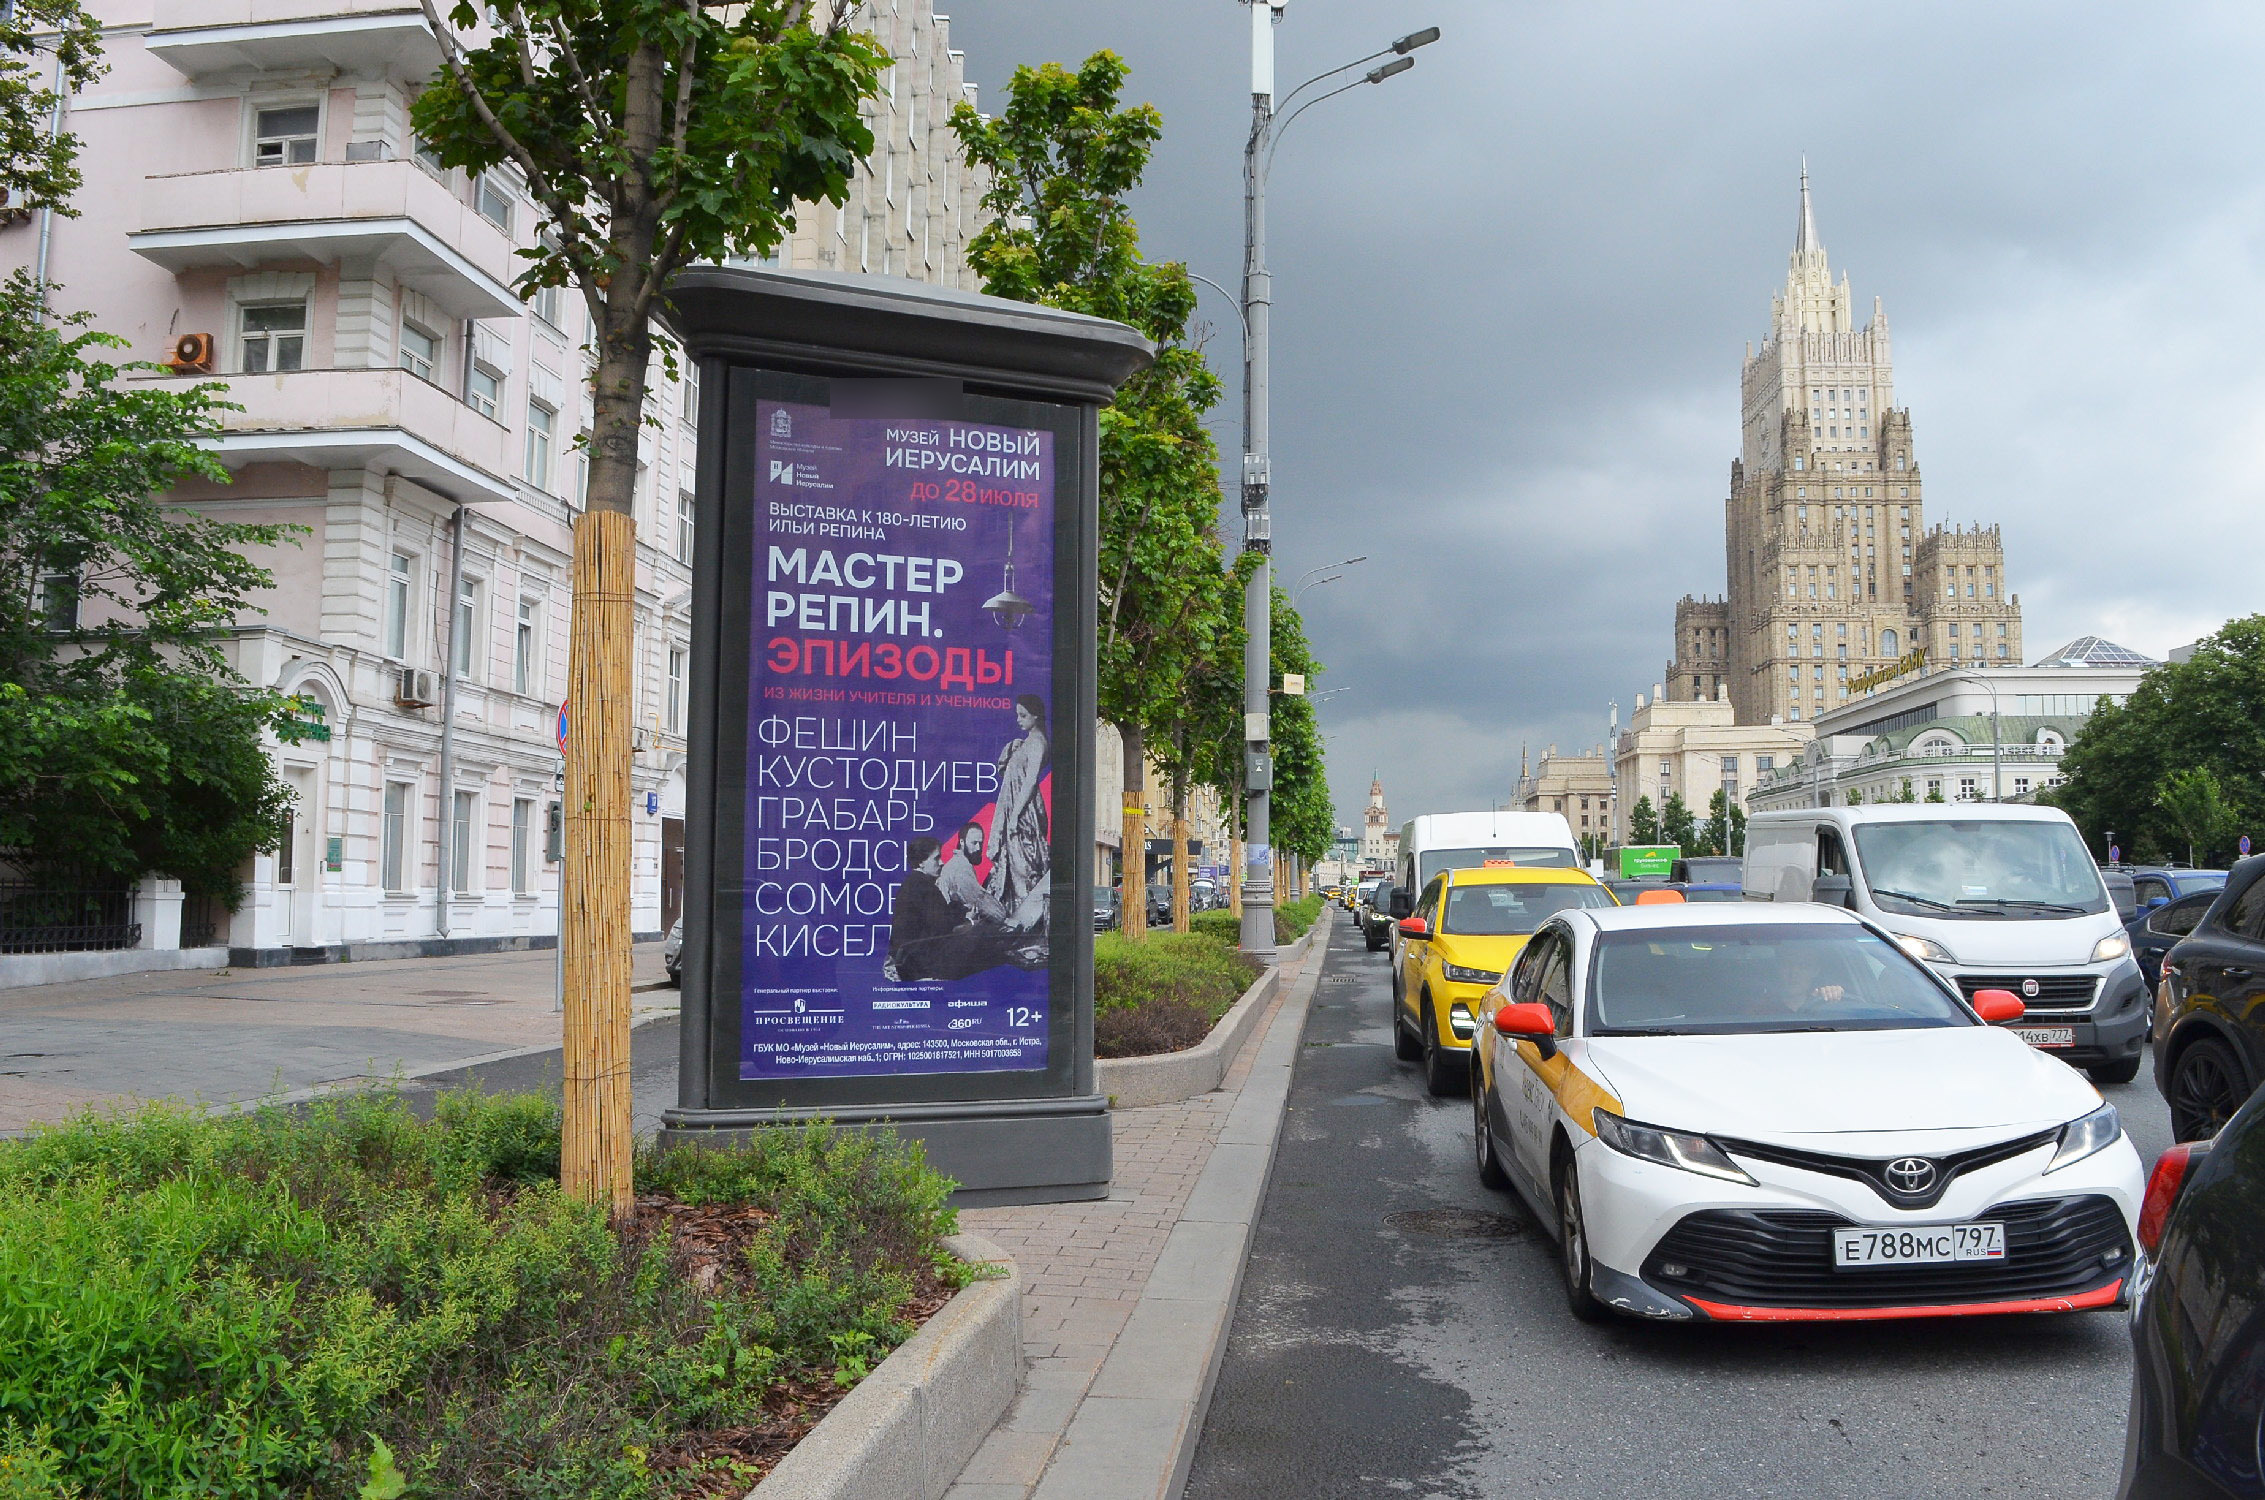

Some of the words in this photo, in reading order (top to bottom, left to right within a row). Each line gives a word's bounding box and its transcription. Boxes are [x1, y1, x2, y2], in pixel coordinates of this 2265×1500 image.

[887, 428, 939, 445] МУЗЕЙ
[950, 428, 1039, 456] НОВЫЙ
[886, 447, 1040, 480] ИЕРУСАЛИМ
[910, 481, 941, 502] ДО
[945, 479, 977, 504] 28
[980, 488, 1040, 509] ИЮЛЯ
[769, 501, 857, 522] ВЫСТАВКА
[862, 510, 873, 524] К
[876, 511, 967, 532] 180-ЛЕТИЮ
[769, 518, 815, 535] ИЛЬИ
[819, 523, 886, 541] РЕПИНА
[767, 545, 964, 594] МАСТЕР
[767, 590, 943, 638] РЕПИН.
[767, 636, 1013, 691] ЭПИЗОДЫ
[764, 686, 784, 699] ИЗ
[789, 687, 845, 702] ЖИЗНИ
[849, 691, 916, 706] УЧИТЕЛЯ
[920, 694, 931, 707] И
[935, 694, 1011, 710] УЧЕНИКОВ
[758, 714, 917, 753] ФЕШИН
[758, 755, 999, 800] КУСТОДИЕВ
[758, 796, 935, 832] ГРАБАРЬ
[947, 999, 988, 1008] афиша
[1006, 1007, 1043, 1027] 12+
[755, 1015, 845, 1025] ПРОСВЕЩЕНИЕ
[753, 1043, 774, 1052] ГБУК
[775, 1042, 789, 1052] МО
[951, 1038, 994, 1047] Московская
[963, 1049, 981, 1058] ИНН
[1955, 1226, 1996, 1249] 797
[1966, 1248, 1986, 1256] RUS
